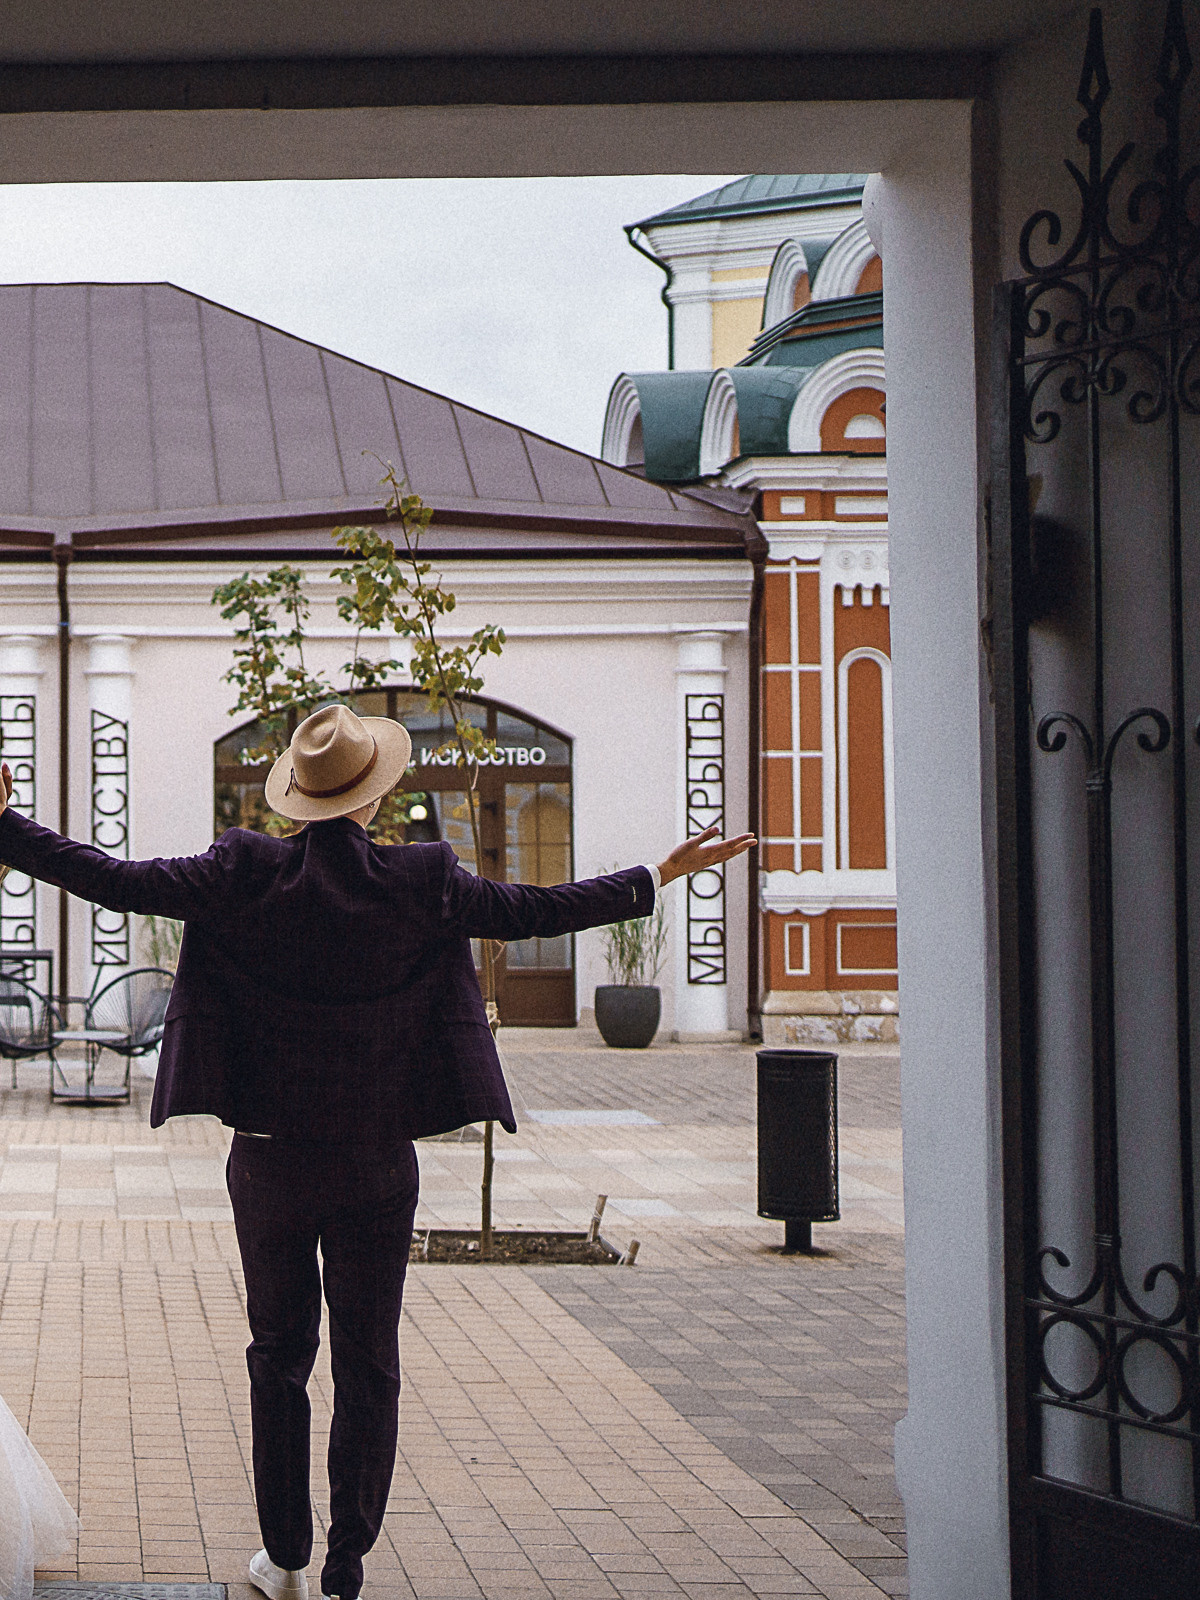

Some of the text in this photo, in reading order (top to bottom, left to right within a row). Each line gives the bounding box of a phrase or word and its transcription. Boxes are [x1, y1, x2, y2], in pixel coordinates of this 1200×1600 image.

[0, 695, 36, 897] ОРЫТЫ
[92, 709, 129, 964] ИСССТВУ
[685, 694, 727, 984] МЫ ОКРЫТЫ
